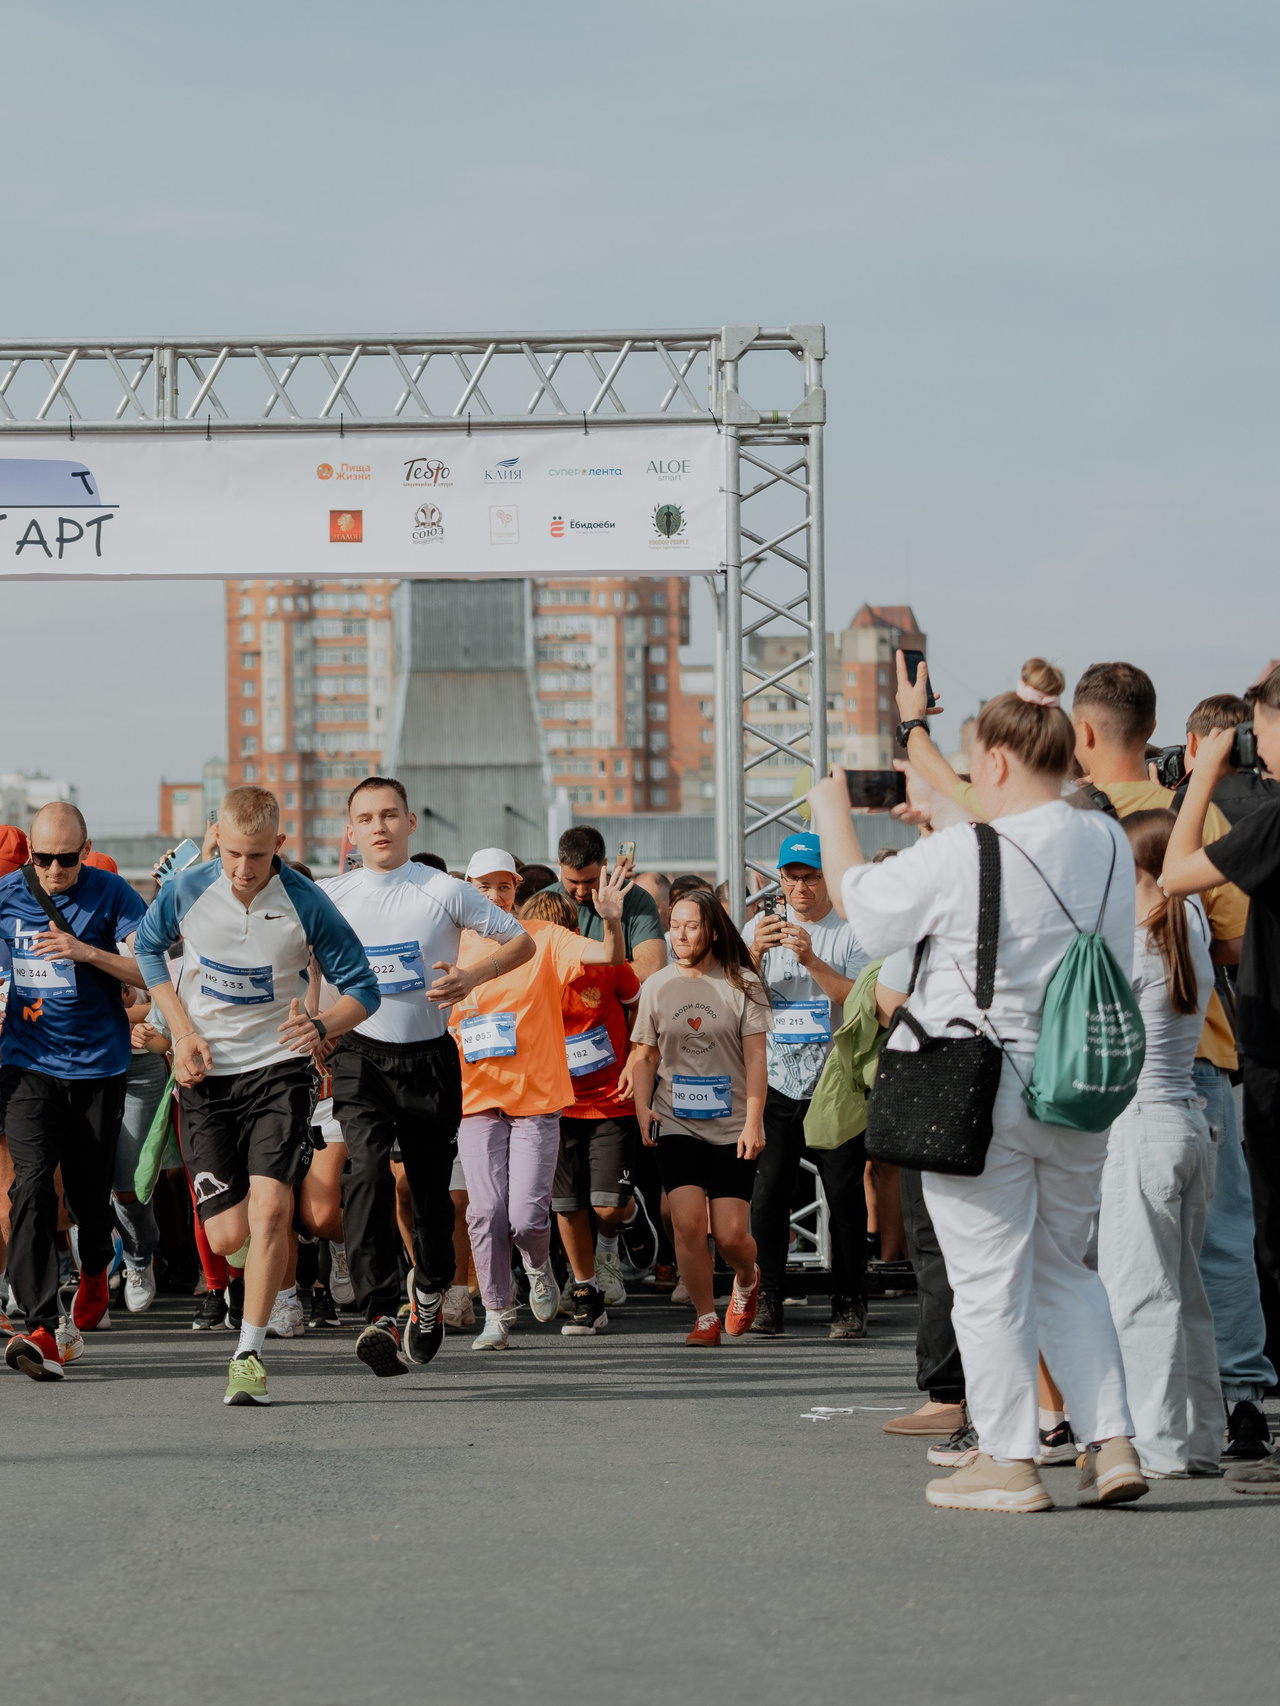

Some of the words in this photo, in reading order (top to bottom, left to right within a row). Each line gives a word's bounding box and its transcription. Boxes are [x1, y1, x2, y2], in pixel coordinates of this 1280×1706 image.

[341, 463, 371, 473] Пища
[646, 459, 691, 474] ALOE
[335, 471, 371, 481] Жизни
[588, 468, 622, 476] лента
[570, 519, 616, 530] Ёбидоёби
[412, 527, 444, 540] СОЮЗ
[29, 969, 47, 978] 344
[372, 964, 395, 974] 022
[222, 979, 244, 990] 333
[672, 1003, 693, 1021] твори
[695, 1002, 718, 1020] добро
[789, 1017, 805, 1026] 213
[681, 1041, 716, 1055] волонтер
[572, 1049, 589, 1059] 182
[688, 1093, 708, 1101] 001
